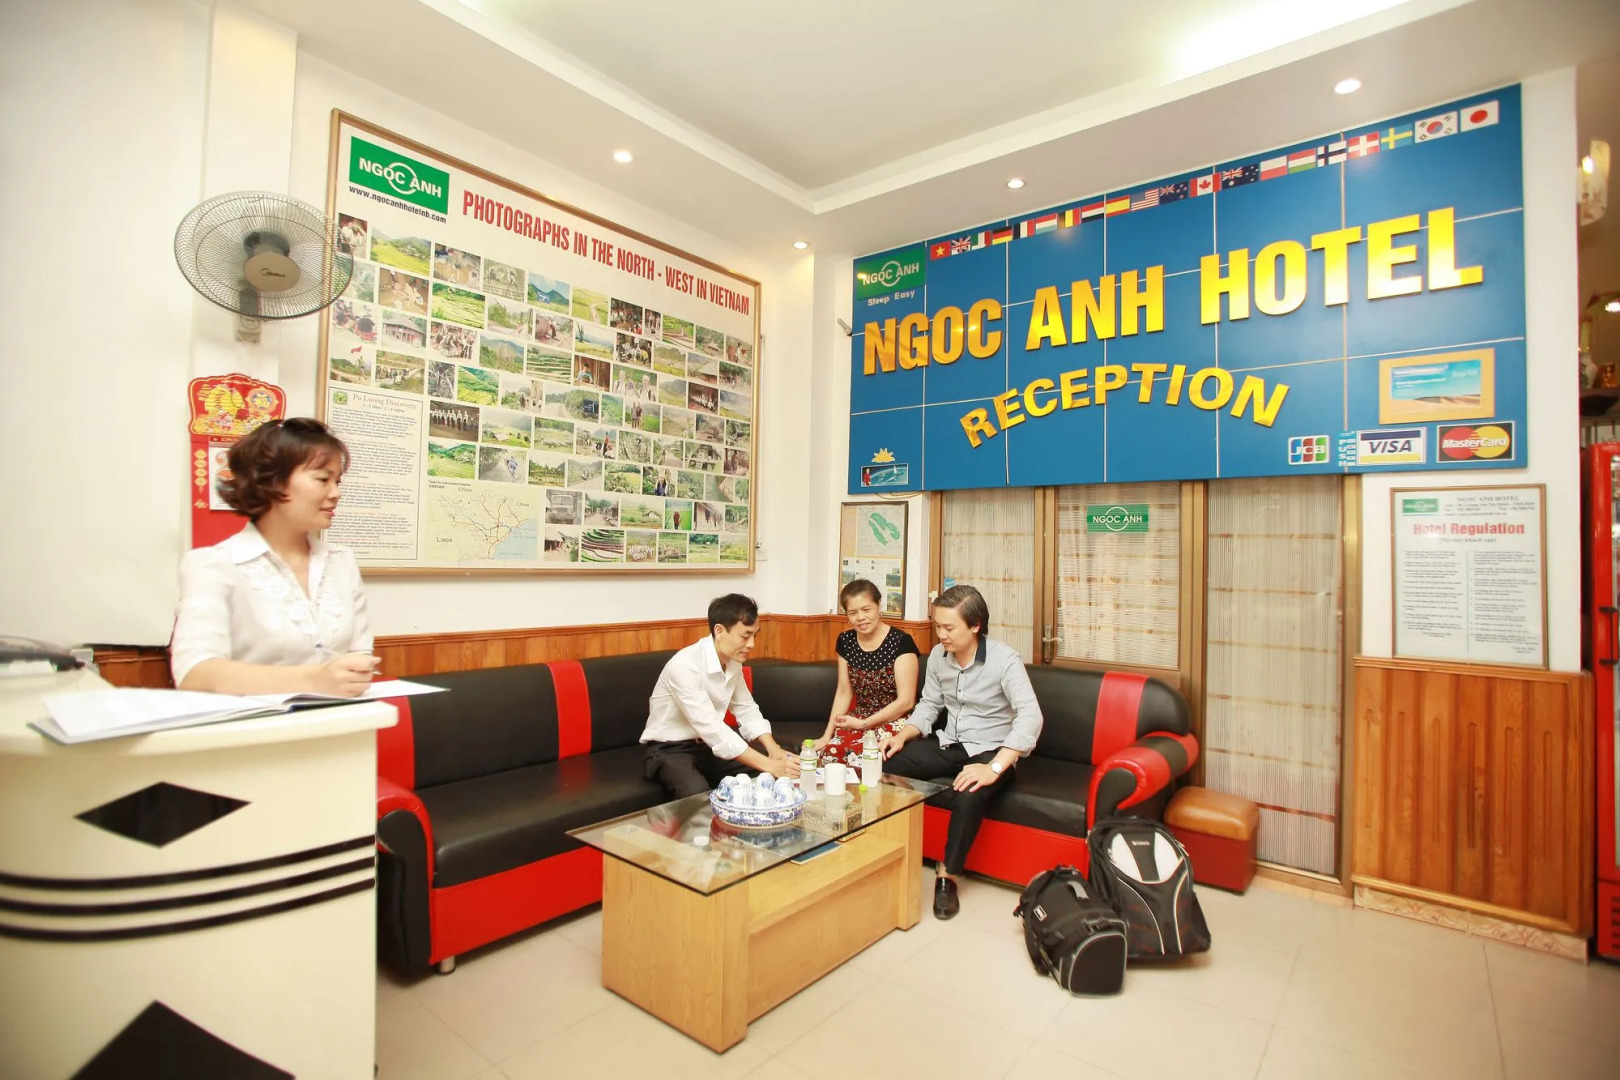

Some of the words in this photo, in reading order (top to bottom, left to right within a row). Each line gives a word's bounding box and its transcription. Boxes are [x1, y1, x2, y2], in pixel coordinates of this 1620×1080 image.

[409, 176, 442, 198] ANH
[349, 185, 447, 224] www.ngocanhhotelnb.com
[463, 189, 570, 251] PHOTOGRAPHS
[573, 231, 588, 257] IN
[591, 238, 614, 267] THE
[617, 247, 655, 281] NORTH
[665, 265, 694, 294] WEST
[697, 277, 707, 300] IN
[709, 282, 750, 316] VIETNAM
[896, 262, 920, 278] ANH
[863, 298, 1003, 376] NGOC
[1025, 264, 1164, 351] ANH
[1200, 207, 1484, 326] HOTEL
[868, 296, 890, 306] Sleep
[894, 290, 915, 300] Easy
[386, 398, 417, 410] Discovery
[959, 362, 1290, 449] RECEPTION
[1369, 440, 1413, 454] VISA
[1442, 436, 1507, 449] MasterCard
[1123, 515, 1143, 523] ANH
[1413, 523, 1446, 535] Hotel
[1450, 522, 1525, 536] Regulation
